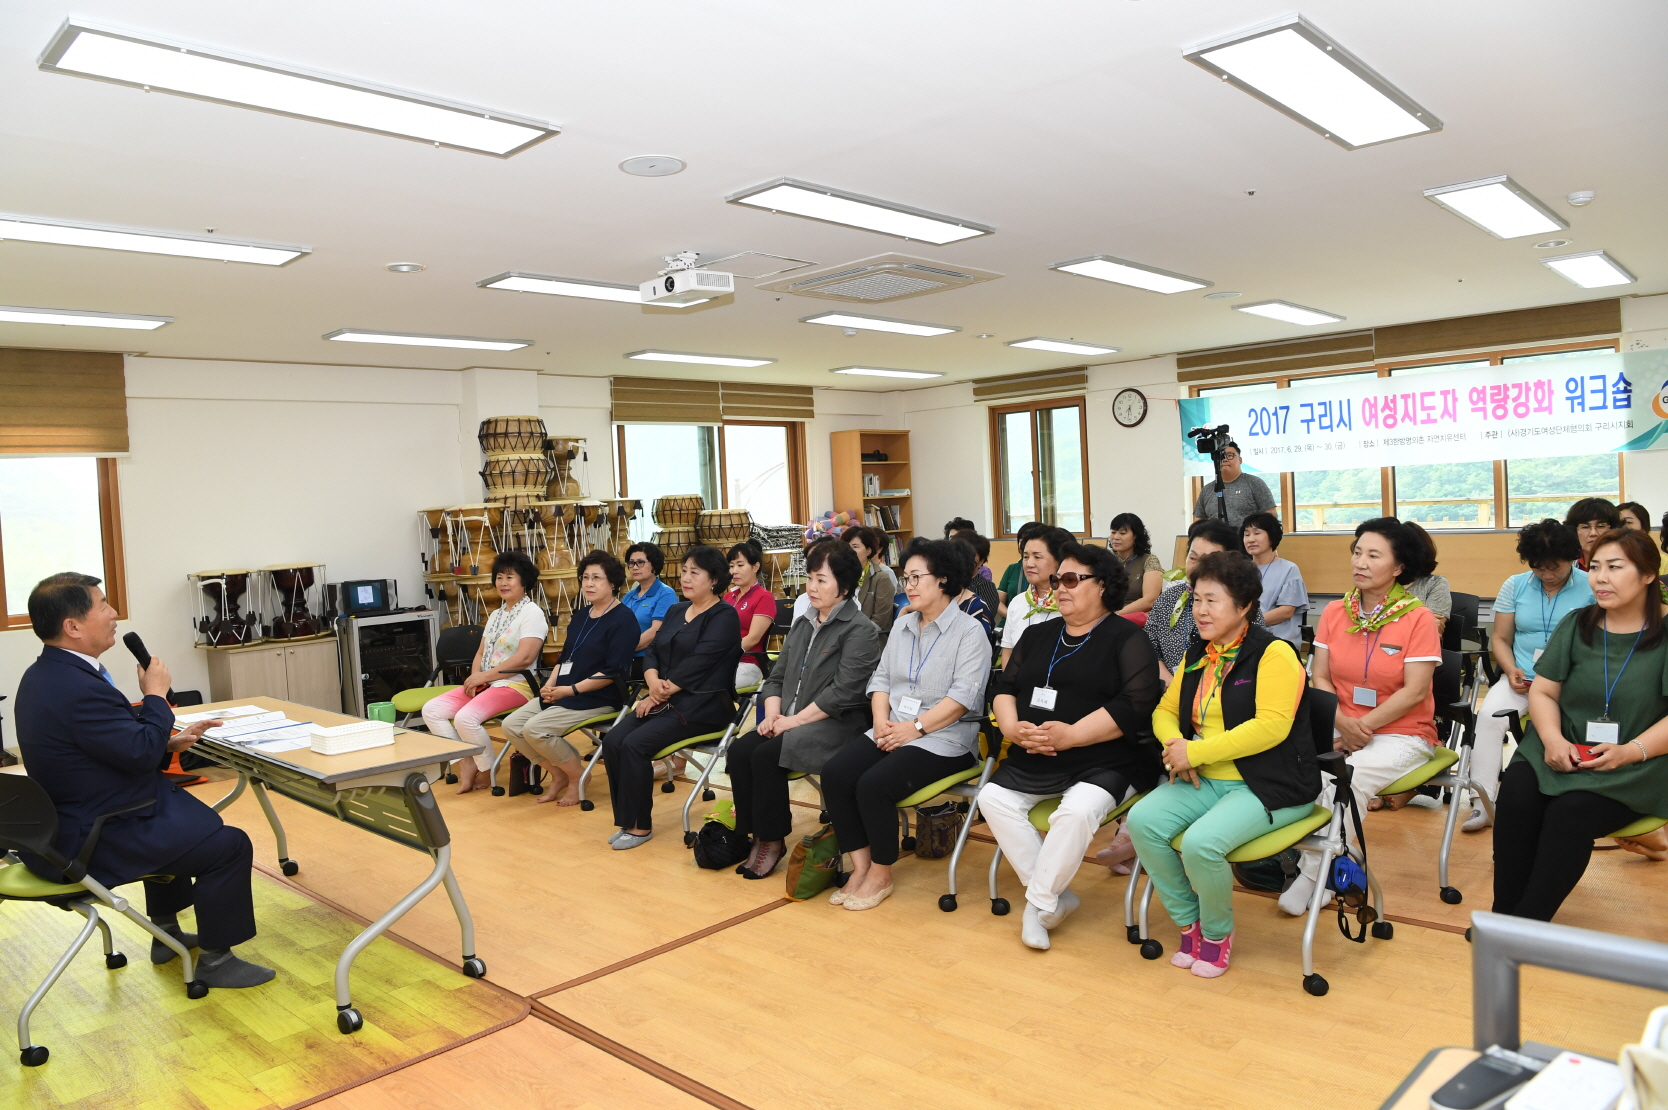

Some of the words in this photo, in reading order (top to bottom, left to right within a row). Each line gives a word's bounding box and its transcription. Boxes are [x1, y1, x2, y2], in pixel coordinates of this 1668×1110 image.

[1248, 405, 1290, 436] 2017
[1299, 399, 1352, 434] 구리시
[1361, 388, 1458, 429] 여성지도자
[1468, 379, 1555, 421] 역량강화
[1565, 371, 1633, 414] 워크숍
[1484, 430, 1499, 440] 주관
[1594, 419, 1634, 432] 구리시지회
